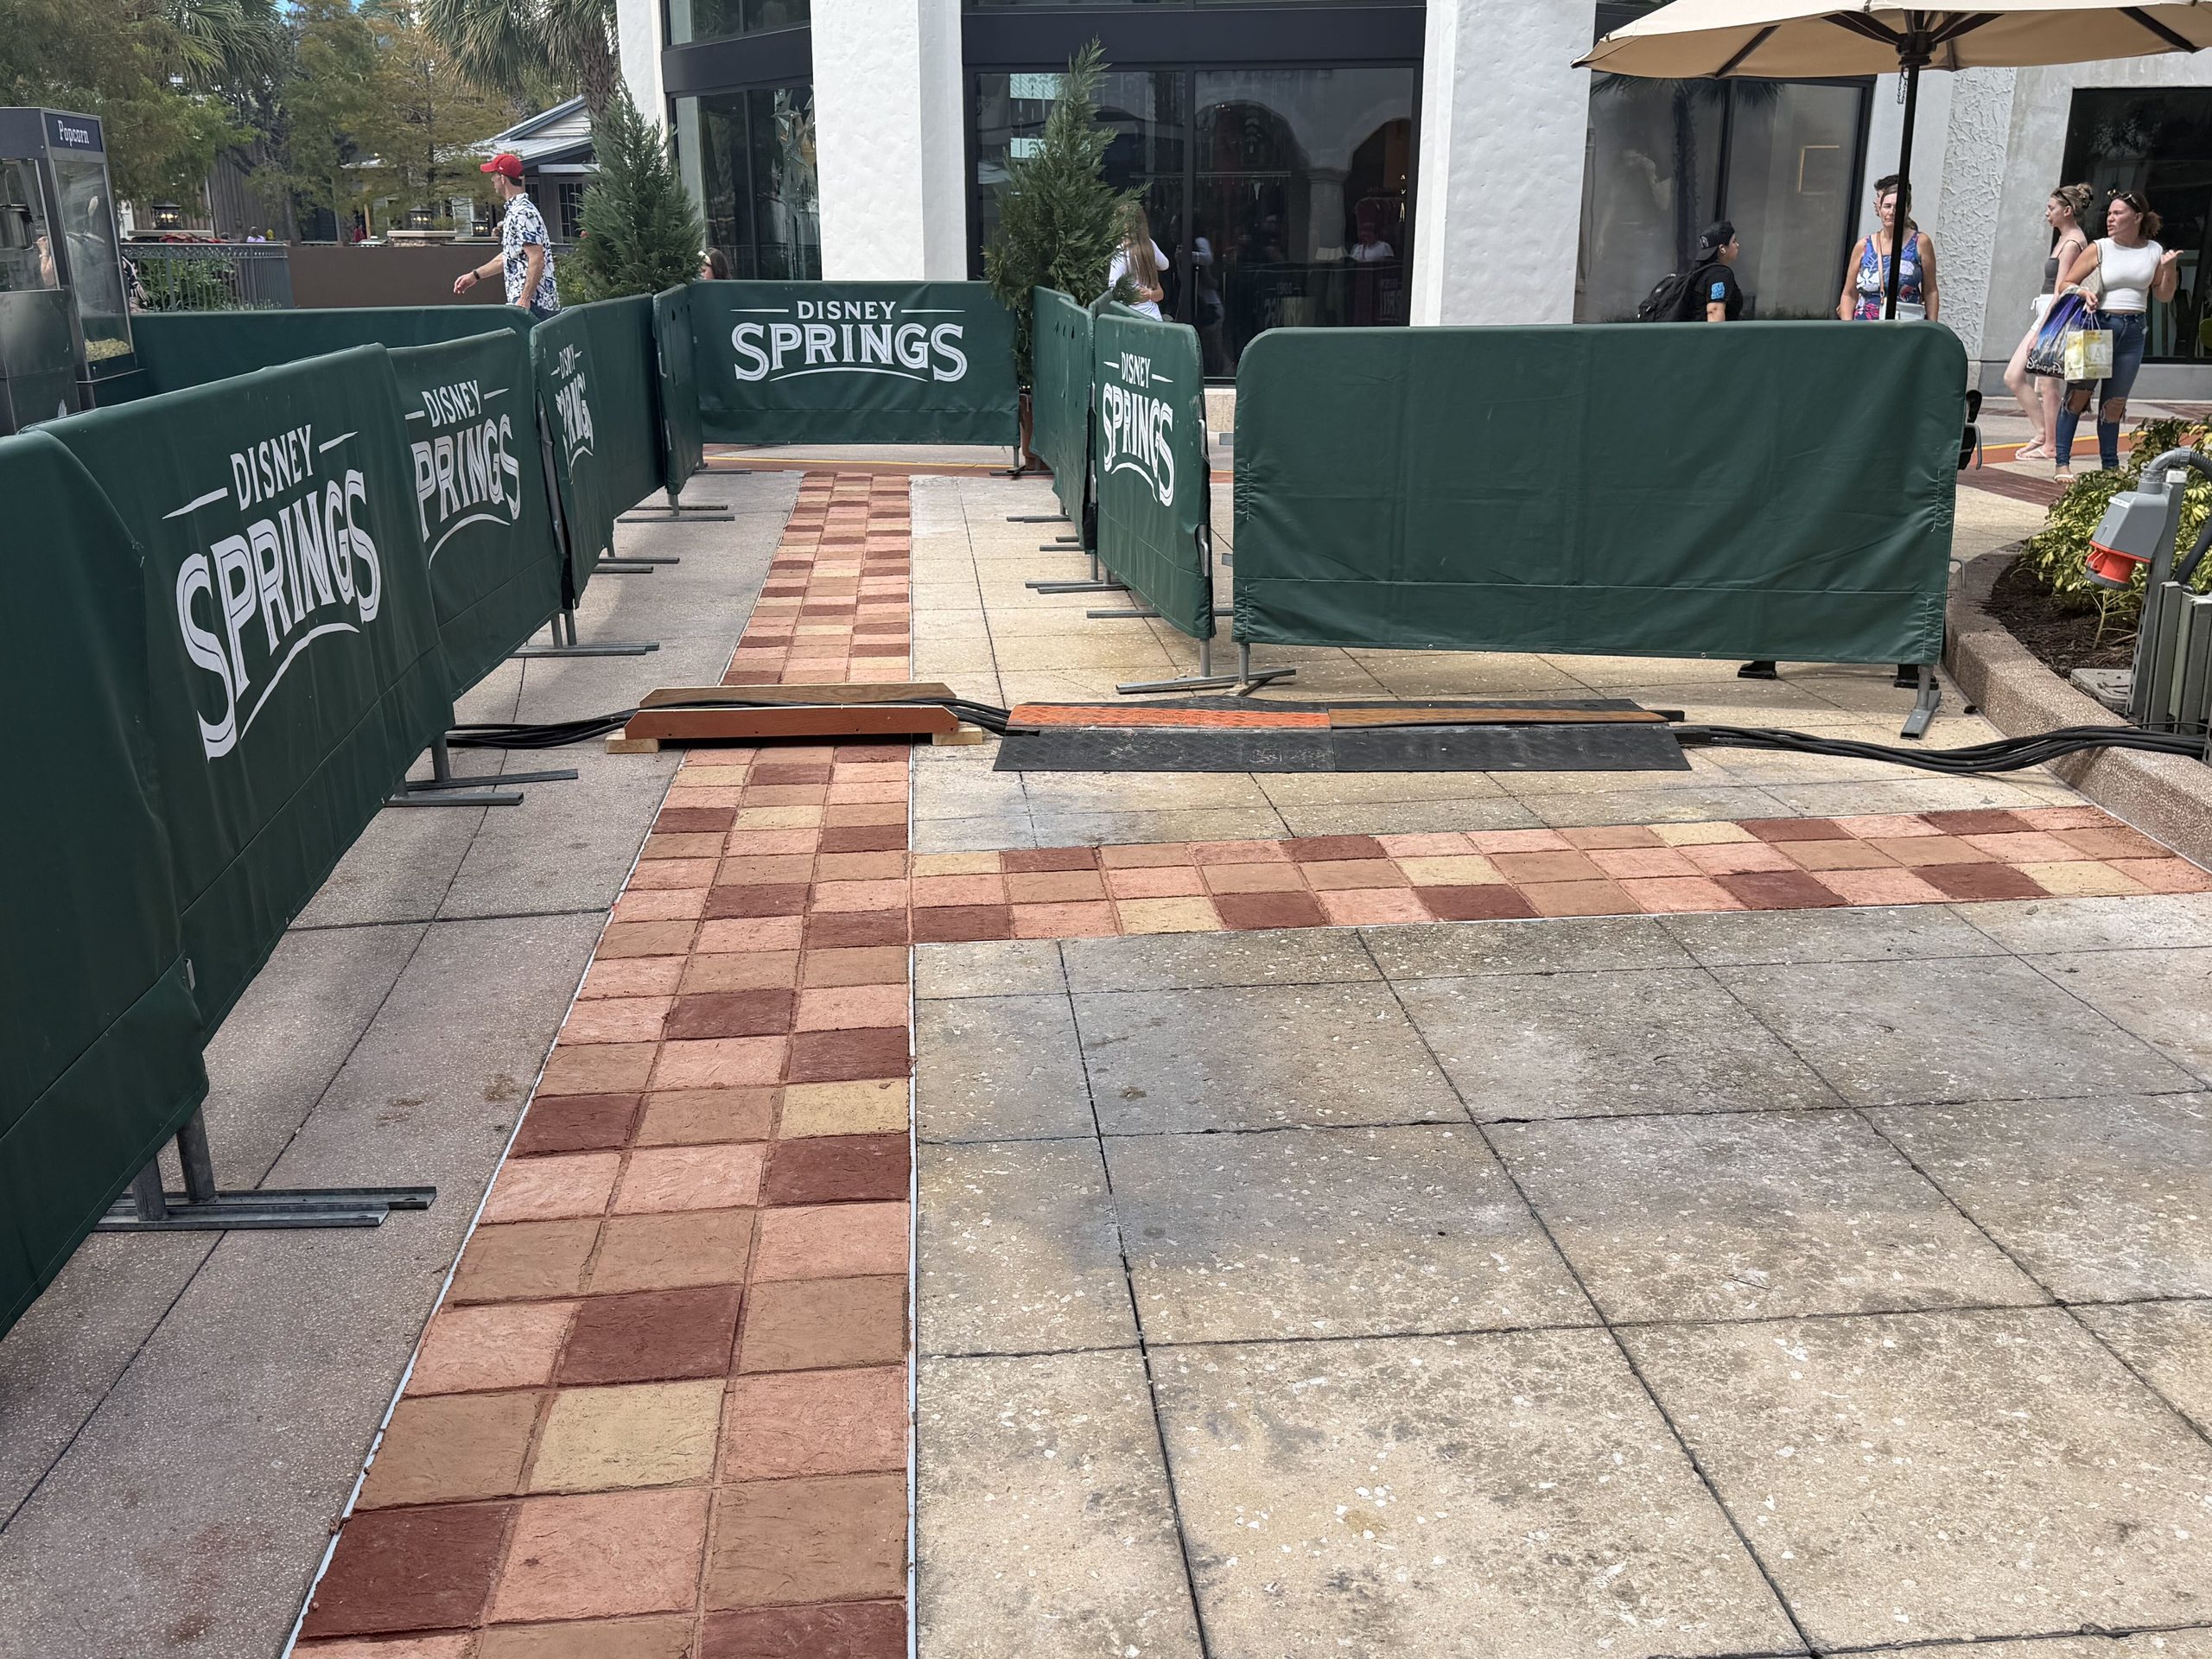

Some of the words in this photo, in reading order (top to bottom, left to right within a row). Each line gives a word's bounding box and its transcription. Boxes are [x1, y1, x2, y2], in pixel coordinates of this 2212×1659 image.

[57, 119, 90, 147] Popcorn
[797, 300, 897, 320] DISNEY
[731, 322, 968, 382] SPRINGS
[1121, 351, 1151, 389] DISNEY
[421, 379, 482, 428] DISNEY
[230, 423, 314, 512] DISNEY
[1103, 382, 1175, 507] SPRINGS
[410, 413, 521, 543] PRINGS
[175, 468, 382, 763] SPRINGS
